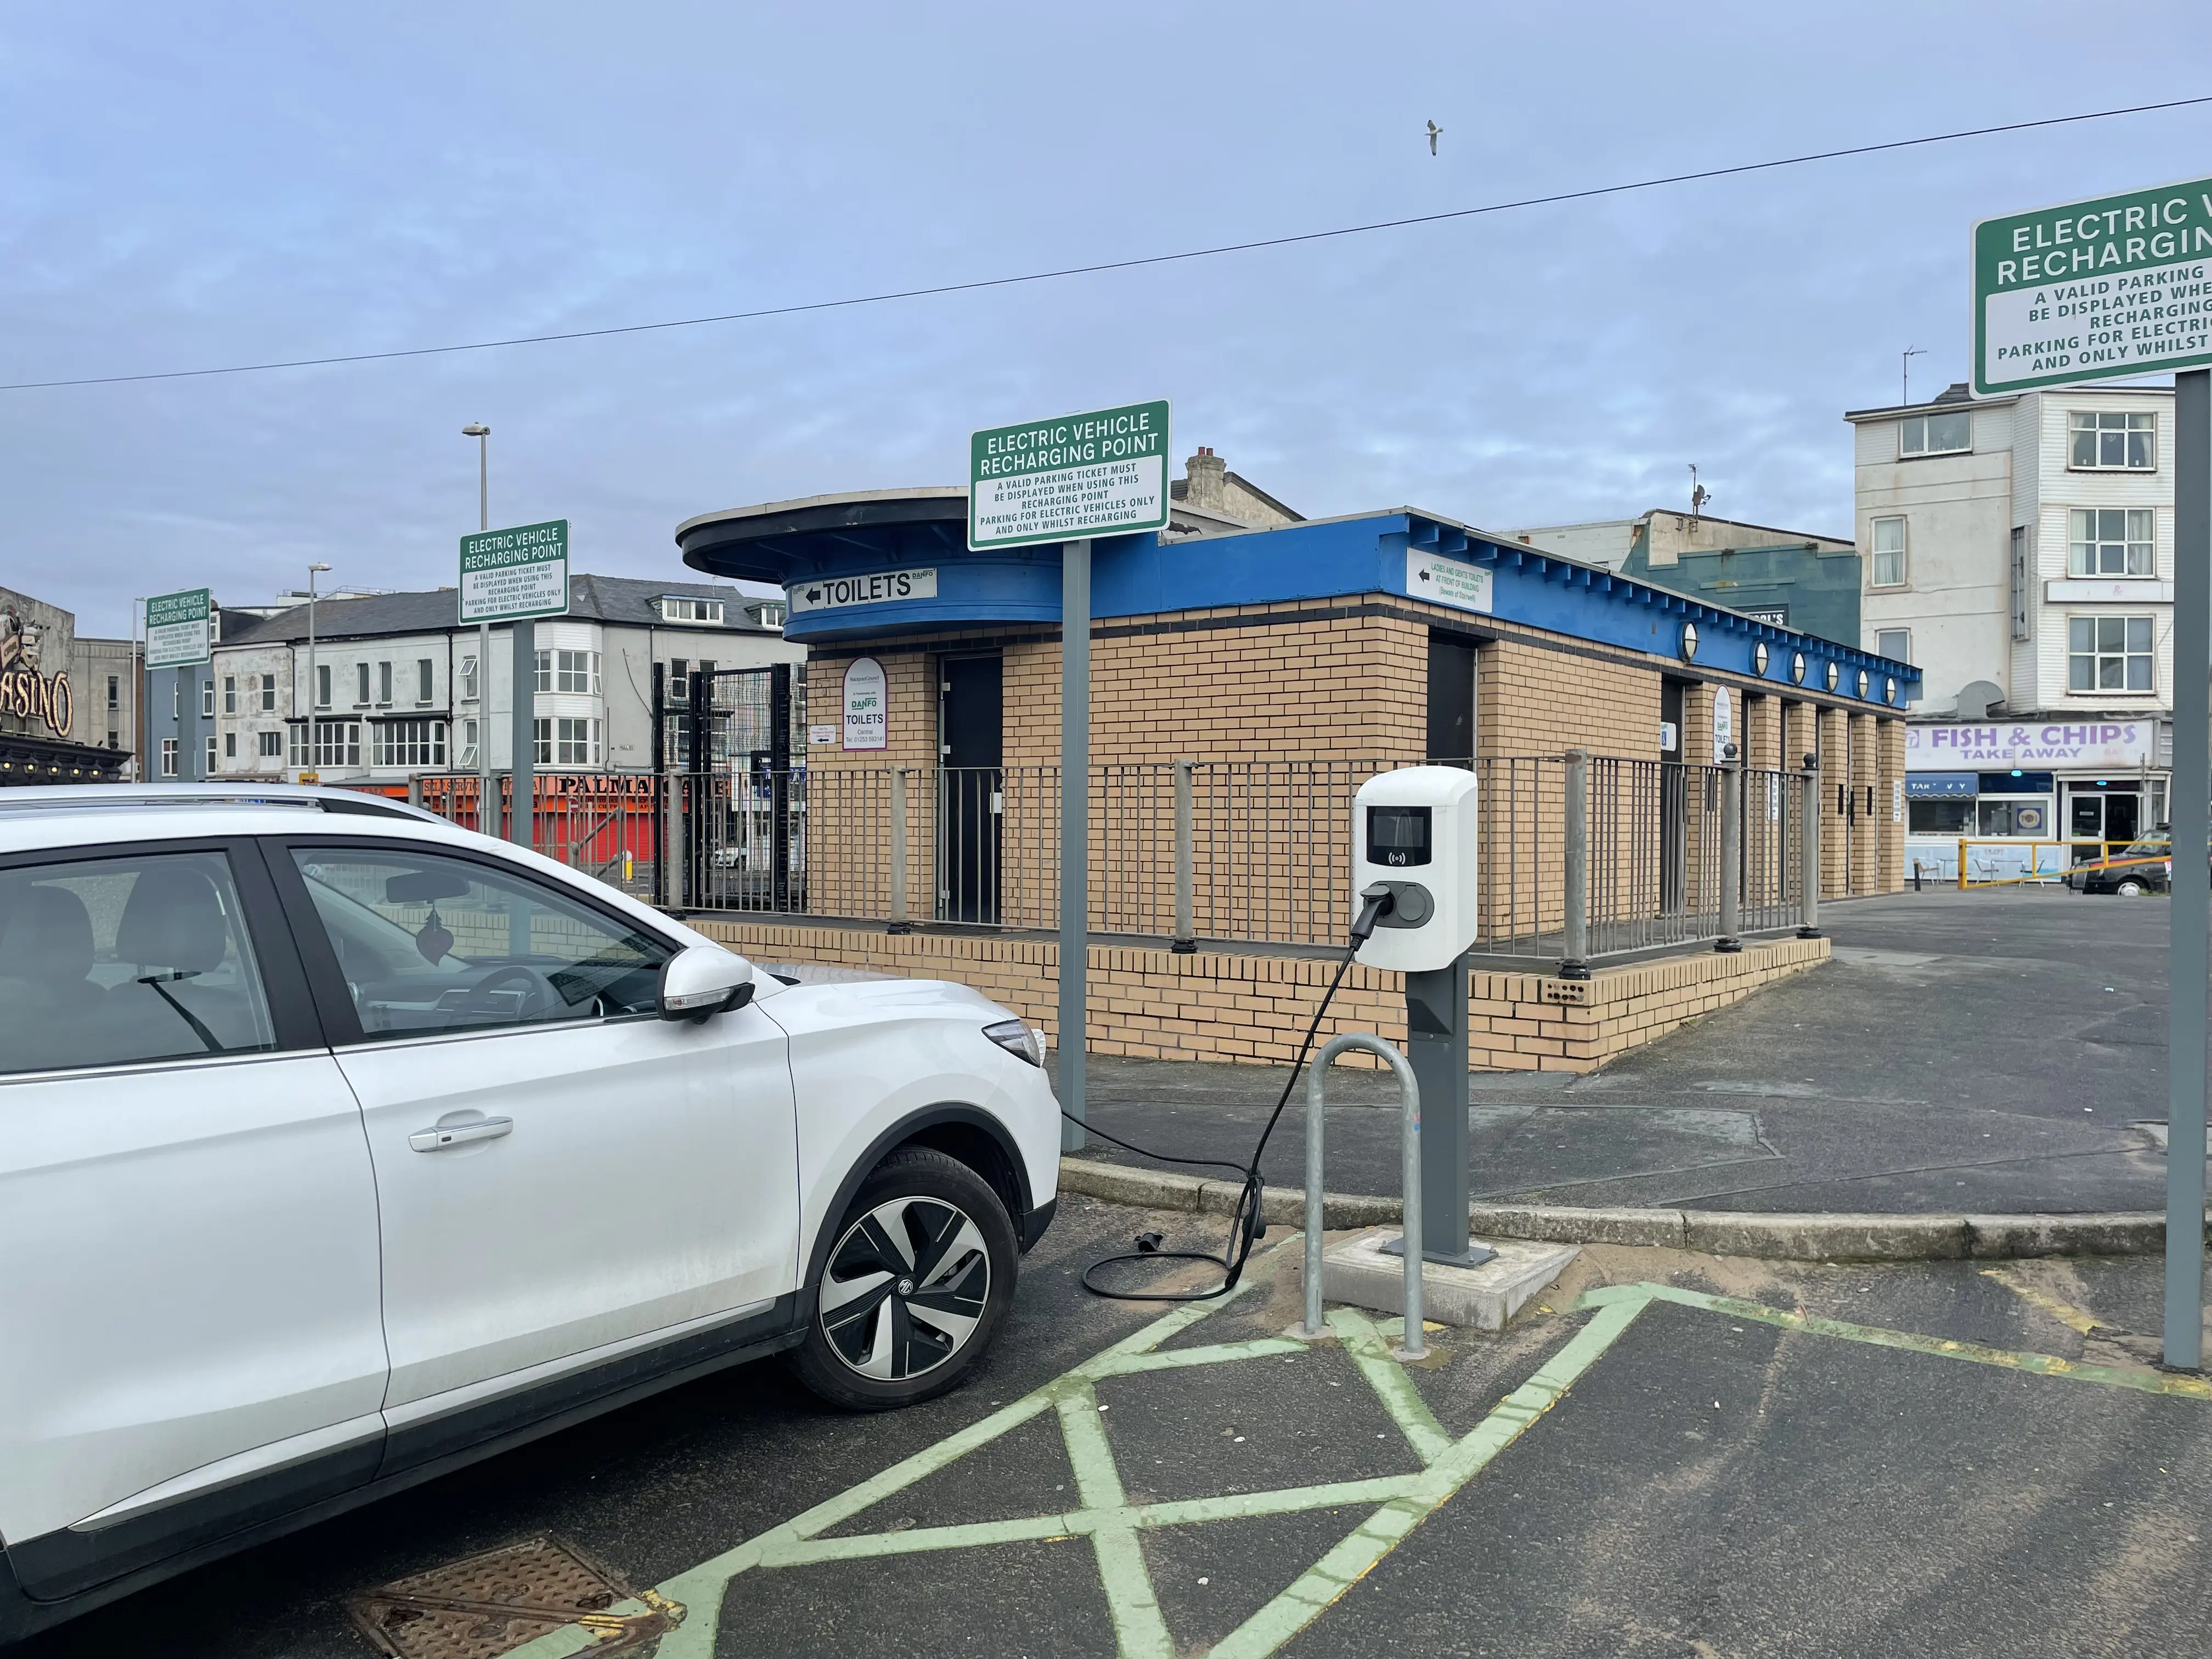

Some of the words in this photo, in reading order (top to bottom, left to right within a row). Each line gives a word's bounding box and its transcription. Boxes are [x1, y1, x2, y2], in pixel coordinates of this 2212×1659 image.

[2013, 198, 2187, 252] ELECTRIC
[2034, 292, 2046, 304] A
[2054, 281, 2109, 301] VALID
[2118, 266, 2204, 291] PARKING
[2029, 307, 2050, 322] BE
[2058, 290, 2162, 318] DISPLAYED
[2090, 298, 2212, 329] RECHARGING
[1998, 336, 2079, 360] PARKING
[2088, 329, 2123, 346] FOR
[2131, 316, 2212, 340] ELECTRI
[2032, 354, 2070, 371] AND
[2079, 346, 2129, 364] ONLY
[2136, 334, 2208, 356] WHILST
[988, 426, 1067, 455] ELECTRIC
[1073, 412, 1149, 441] VEHICLE
[980, 443, 1094, 476] RECHARGING
[1102, 432, 1158, 458] POINT
[997, 482, 1003, 491] A
[1006, 478, 1031, 490] VALID
[1035, 472, 1074, 486] PARKING
[1077, 467, 1107, 480] TICKET
[1110, 462, 1136, 475] MUST
[995, 493, 1005, 502] BE
[1007, 486, 1054, 500] DISPLAYED
[1058, 483, 1083, 494] WHEN
[1087, 477, 1115, 490] USING
[1118, 474, 1139, 486] THIS
[980, 513, 1017, 526] PARKING
[1020, 510, 1037, 521] FOR
[1040, 505, 1080, 518] ELECTRIC
[1084, 499, 1126, 514] VEHICLES
[1130, 495, 1155, 507] ONLY
[1022, 495, 1077, 510] RECHARGING
[1081, 490, 1109, 501] POINT
[996, 526, 1013, 535] AND
[1016, 522, 1039, 533] ONLY
[1042, 518, 1074, 529] WHILST
[1077, 509, 1137, 525] RECHARGING
[469, 535, 513, 554] ELECTRIC
[516, 527, 558, 546] VEHICLE
[465, 548, 528, 569] RECHARGING
[532, 543, 563, 560] POINT
[479, 572, 494, 580] VALID
[495, 569, 517, 578] PARKING
[518, 566, 535, 574] TICKET
[537, 564, 551, 572] MUST
[480, 578, 506, 589] DISPLAYED
[508, 577, 522, 585] WHEN
[523, 574, 539, 583] USING
[912, 571, 933, 579] DANFO
[1431, 562, 1446, 573] LADIES
[1454, 569, 1468, 579] GENTS
[1469, 572, 1483, 584] TOILETS
[488, 585, 519, 596] RECHARGING
[521, 583, 536, 591] POINT
[823, 573, 911, 605] TOILETS
[1441, 575, 1455, 586] FRONT
[1455, 579, 1460, 588] OF
[1462, 580, 1479, 592] BUILDING
[151, 599, 178, 612] ELECTRIC
[179, 594, 204, 608] VEHICLE
[465, 597, 486, 607] PARKING
[498, 593, 521, 603] ELECTRIC
[522, 590, 545, 600] VEHICLES
[547, 589, 561, 597] ONLY
[1439, 586, 1454, 597] (Beware
[1459, 591, 1476, 603] Stairwell)
[149, 609, 187, 625] RECHARGING
[188, 606, 207, 619] POINT
[486, 605, 498, 613] ONLY
[499, 602, 517, 611] WHILST
[519, 599, 551, 609] RECHARGING
[851, 698, 877, 710] DANFO
[847, 714, 883, 725] TOILETS
[1715, 734, 1730, 743] TOILETS
[1932, 728, 1997, 747] FISH
[2008, 727, 2030, 746] &
[2041, 724, 2136, 746] CHIPS
[1960, 749, 2013, 759] TAKE
[2021, 748, 2081, 758] AWAY
[558, 778, 652, 794] PALMA
[899, 1280, 912, 1294] MG
